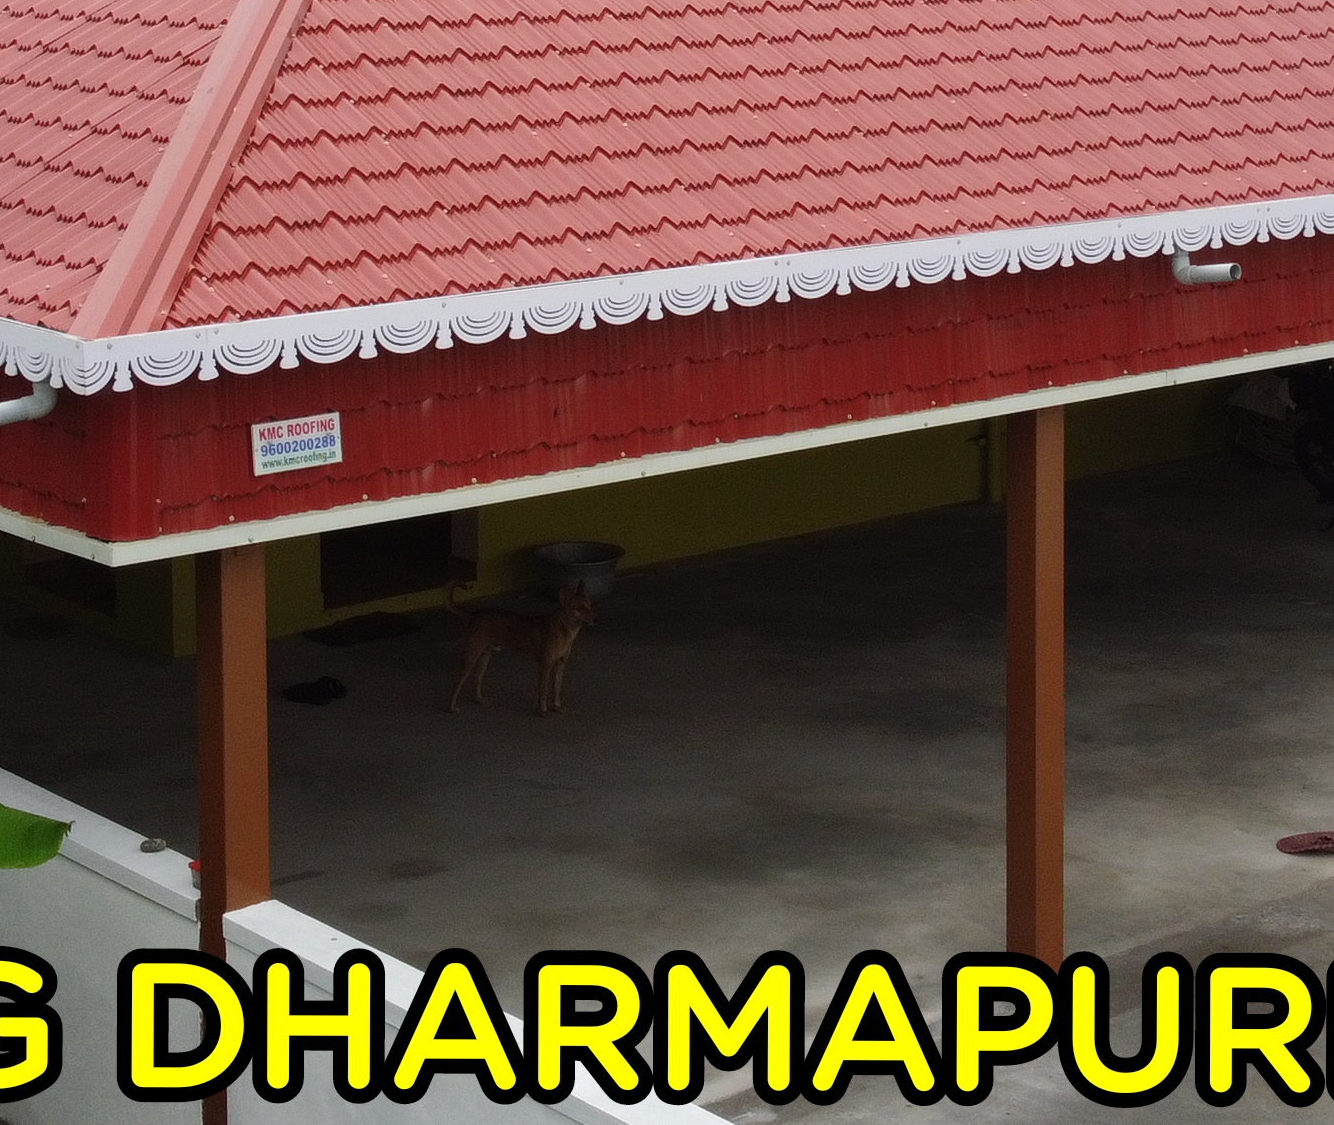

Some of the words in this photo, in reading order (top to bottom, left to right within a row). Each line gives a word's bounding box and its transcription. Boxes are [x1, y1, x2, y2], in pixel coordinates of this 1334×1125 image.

[259, 426, 284, 441] KMC
[287, 418, 335, 437] ROOFING
[261, 435, 336, 457] 9600200288
[261, 449, 337, 469] www.kmcroofing.in
